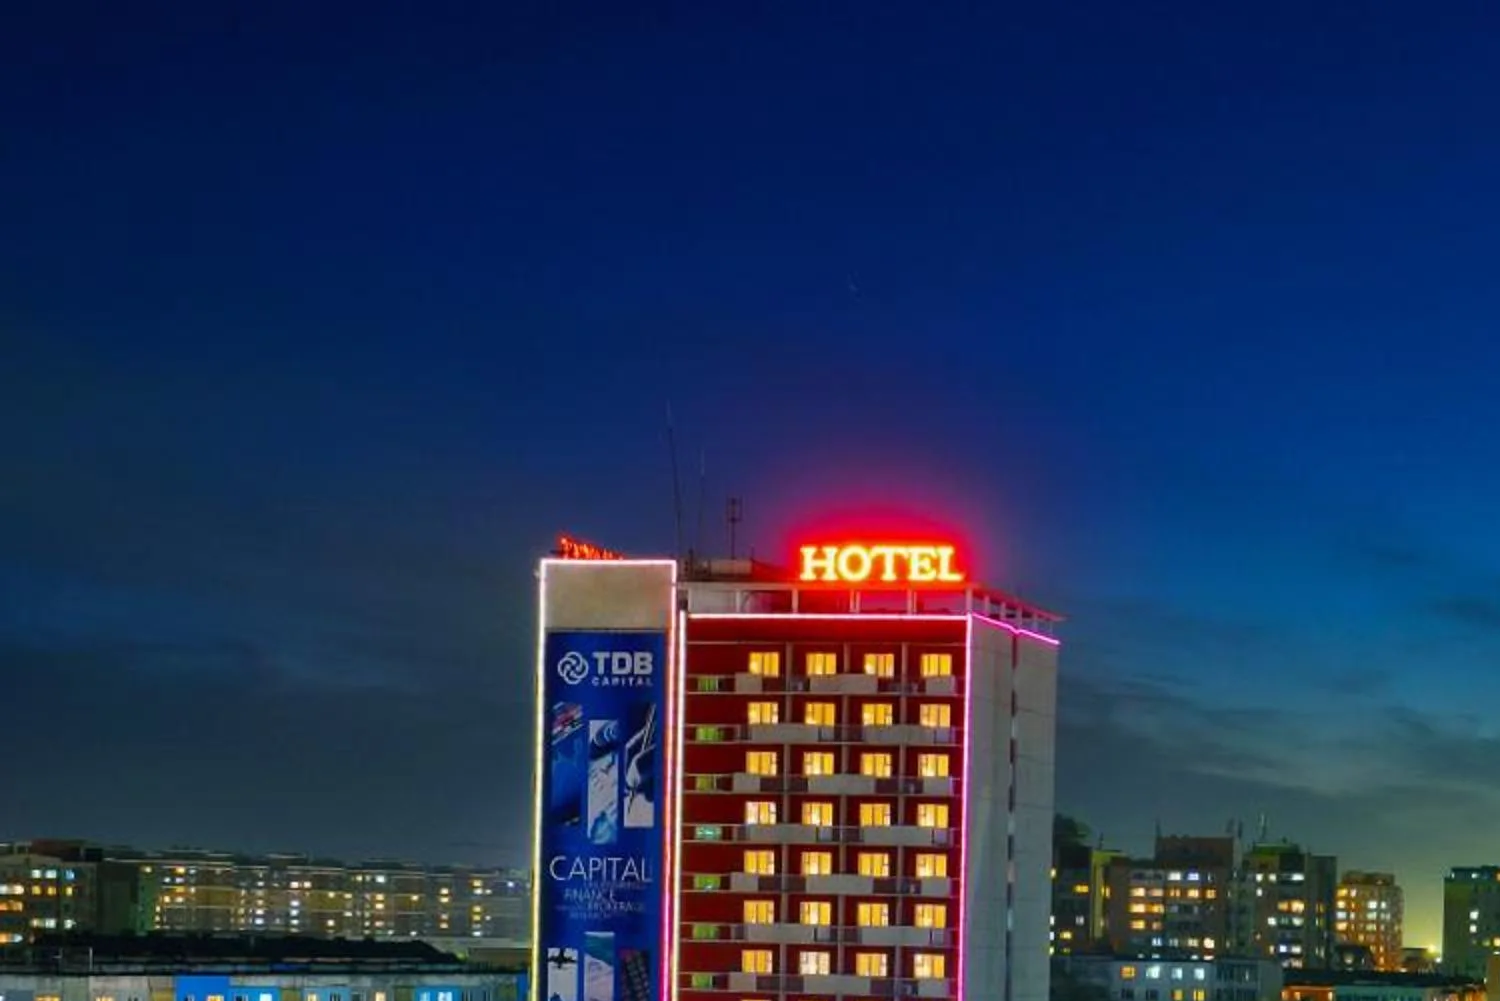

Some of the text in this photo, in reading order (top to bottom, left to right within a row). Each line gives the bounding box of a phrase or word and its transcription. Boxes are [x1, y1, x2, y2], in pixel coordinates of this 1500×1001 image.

[800, 546, 965, 582] HOTEL
[592, 651, 653, 675] TDB
[591, 677, 653, 687] CAPITAL
[549, 856, 653, 882] CAPITAL
